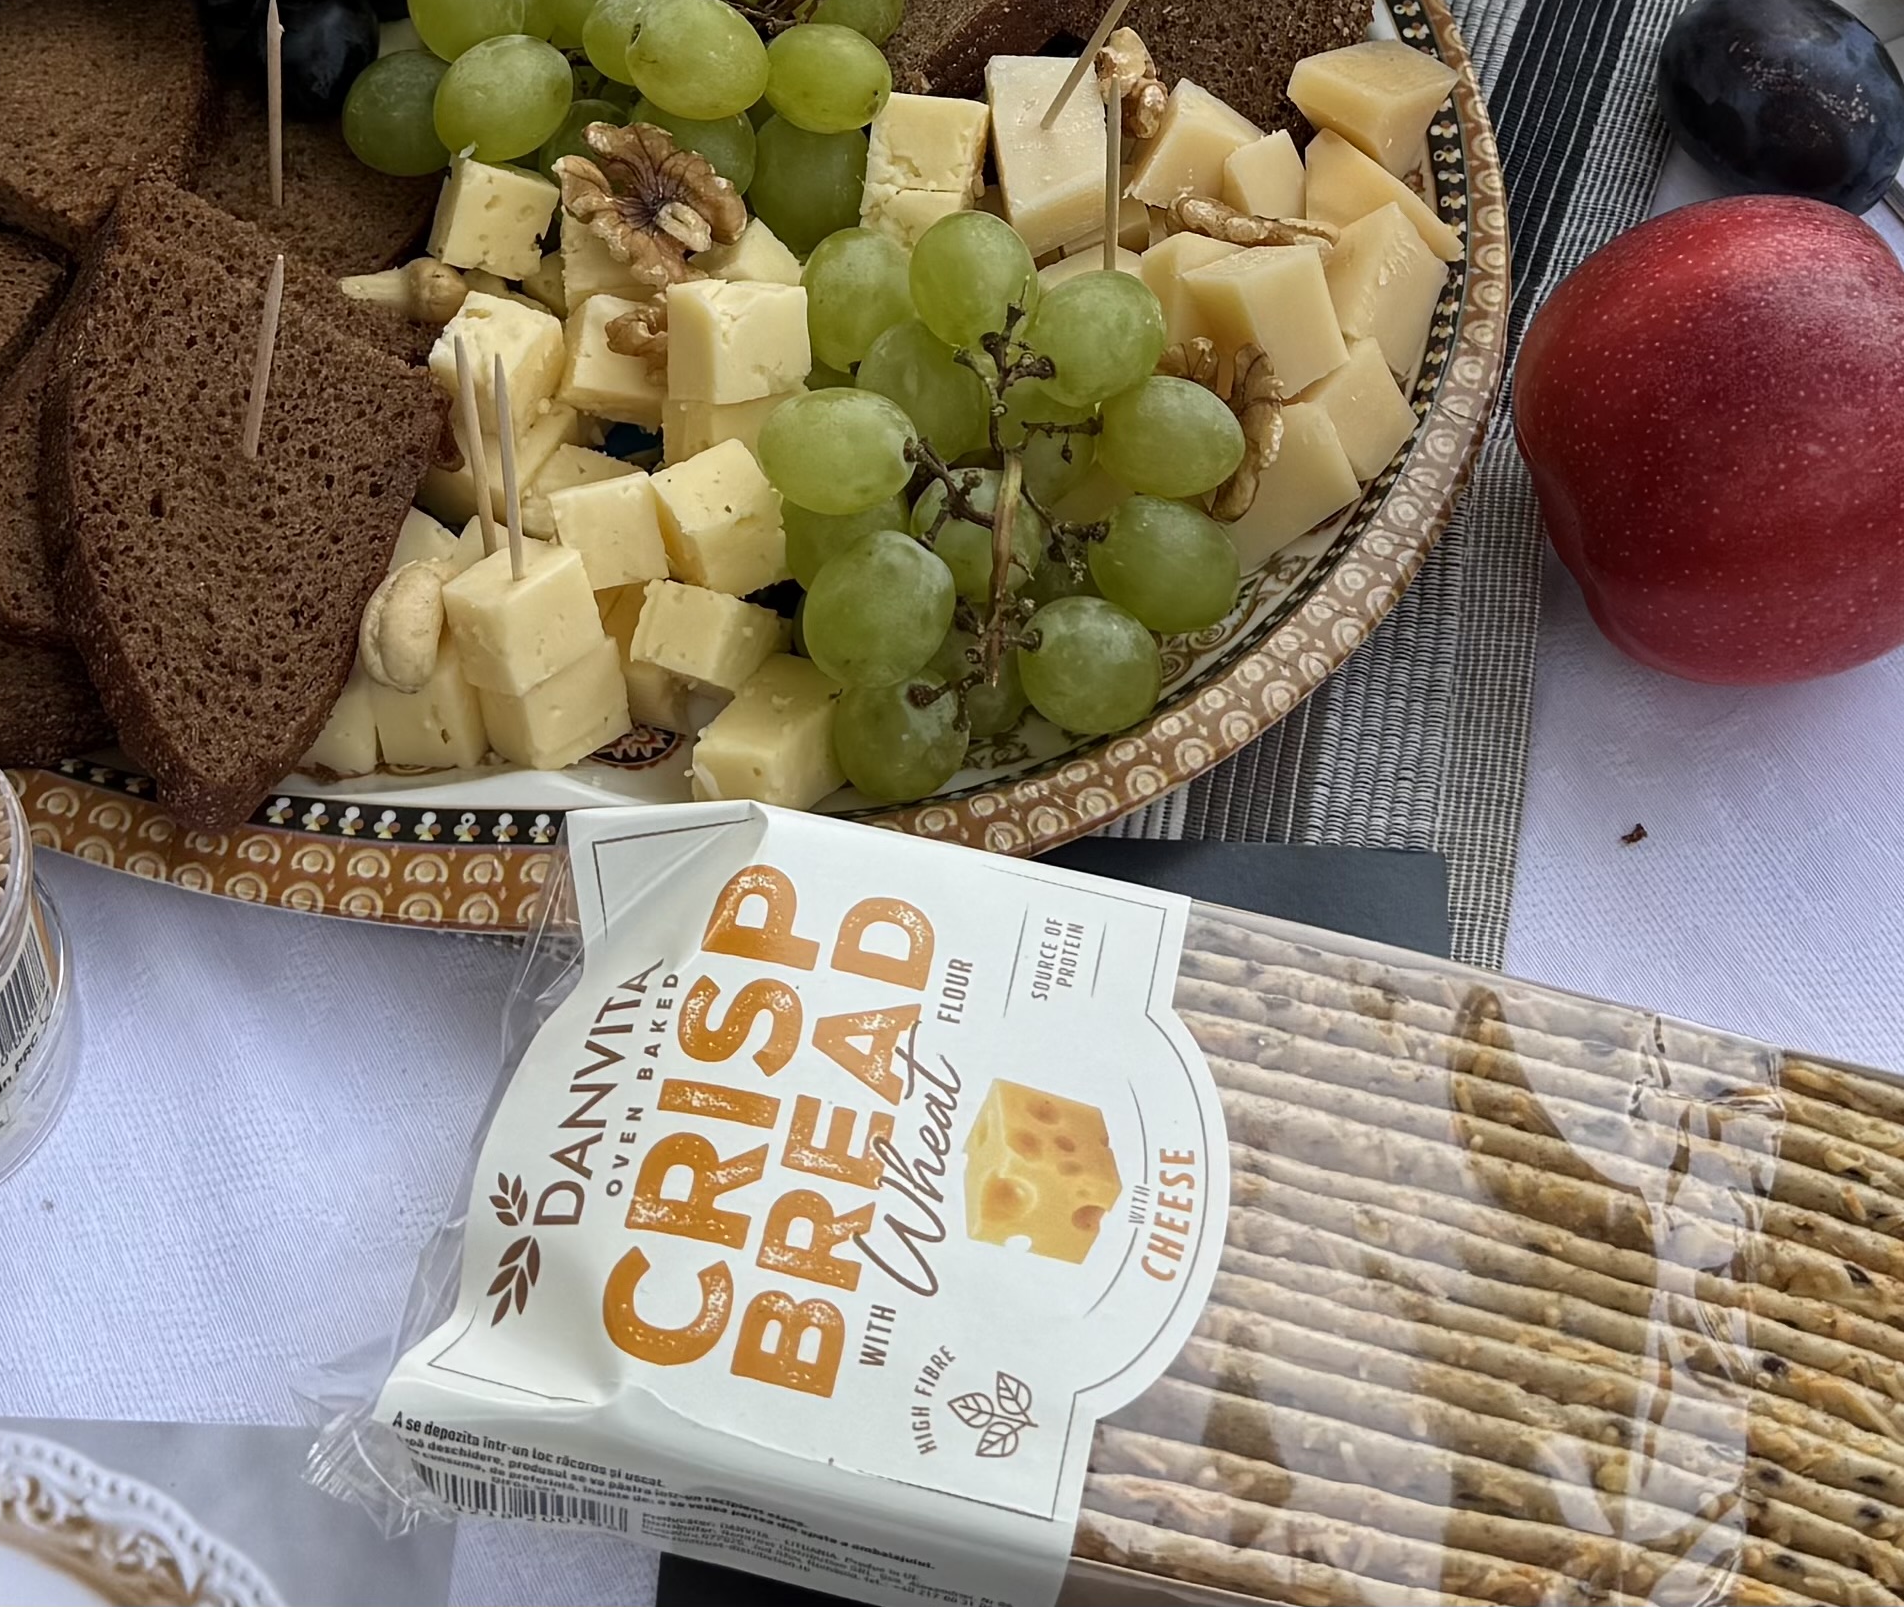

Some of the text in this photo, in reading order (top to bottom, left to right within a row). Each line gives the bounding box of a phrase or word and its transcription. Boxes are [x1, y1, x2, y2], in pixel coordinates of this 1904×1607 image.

[1030, 916, 1061, 1002] SOURCE OF
[1055, 922, 1086, 990] PROTEIN
[532, 956, 664, 1227] DANVITA
[601, 863, 821, 1368] CRISP
[604, 971, 680, 1199] OVEN BAKED
[730, 895, 937, 1399] BREAD
[852, 956, 973, 1369] WITH Wheat FLOUR
[1126, 1184, 1148, 1226] WITH
[1140, 1146, 1197, 1284] CHEESE
[390, 1409, 406, 1429] A
[403, 1416, 423, 1434] se
[421, 1419, 482, 1448] depozita
[530, 1446, 555, 1464] loc
[916, 1344, 959, 1456] HIGH FIBRE
